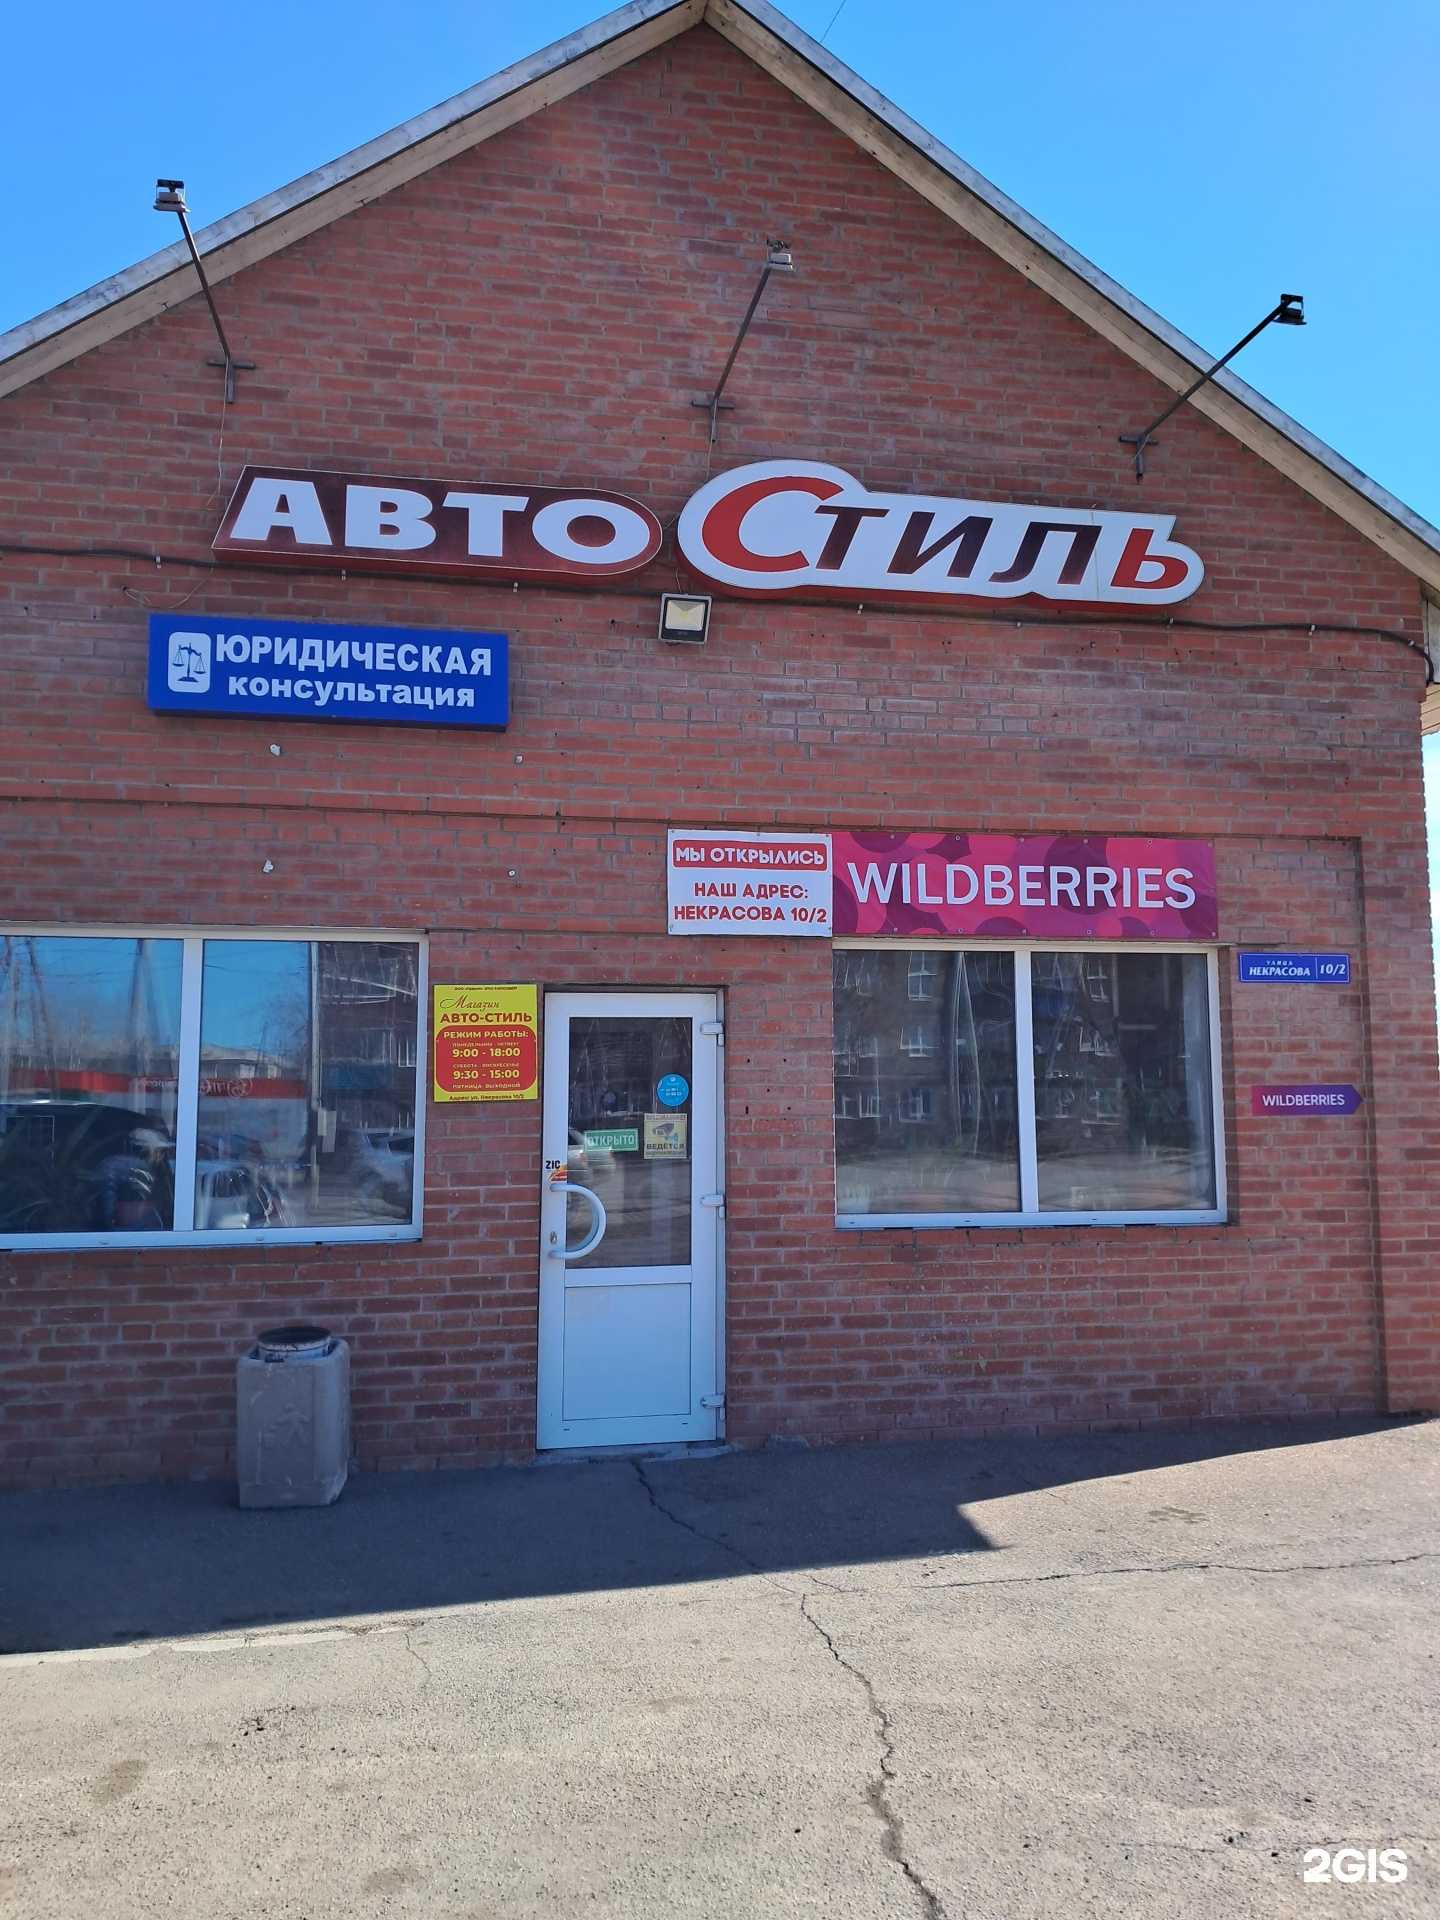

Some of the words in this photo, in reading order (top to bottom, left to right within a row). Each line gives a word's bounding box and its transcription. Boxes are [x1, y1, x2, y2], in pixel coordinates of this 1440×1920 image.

[229, 478, 650, 565] АВТО
[215, 633, 492, 677] ЮРИДИЧЕСКАЯ
[228, 674, 475, 710] консультация
[675, 846, 705, 862] МЫ
[710, 847, 825, 865] ОТКРЫЛИСЬ
[694, 882, 737, 897] НАШ
[742, 883, 809, 900] АДРЕС:
[847, 861, 1197, 910] WILDBERRIES
[673, 905, 786, 922] НЕКРАСОВА
[790, 907, 828, 924] 10/2
[1248, 966, 1312, 977] НЕКРАСОВА
[1319, 963, 1347, 976] 10/2
[440, 1012, 532, 1024] АВТО-СТИЛЬ
[443, 1031, 482, 1039] РЕЖИМ
[484, 1030, 529, 1038] РАБОТЫ:
[452, 1048, 479, 1058] 9:00
[490, 1047, 521, 1057] 18:00
[452, 1070, 479, 1080] 9:30
[489, 1069, 521, 1079] 15:00
[1262, 1093, 1346, 1107] WILDBERRIES
[586, 1134, 635, 1146] ОТКРЫТО
[545, 1159, 561, 1170] ZIC
